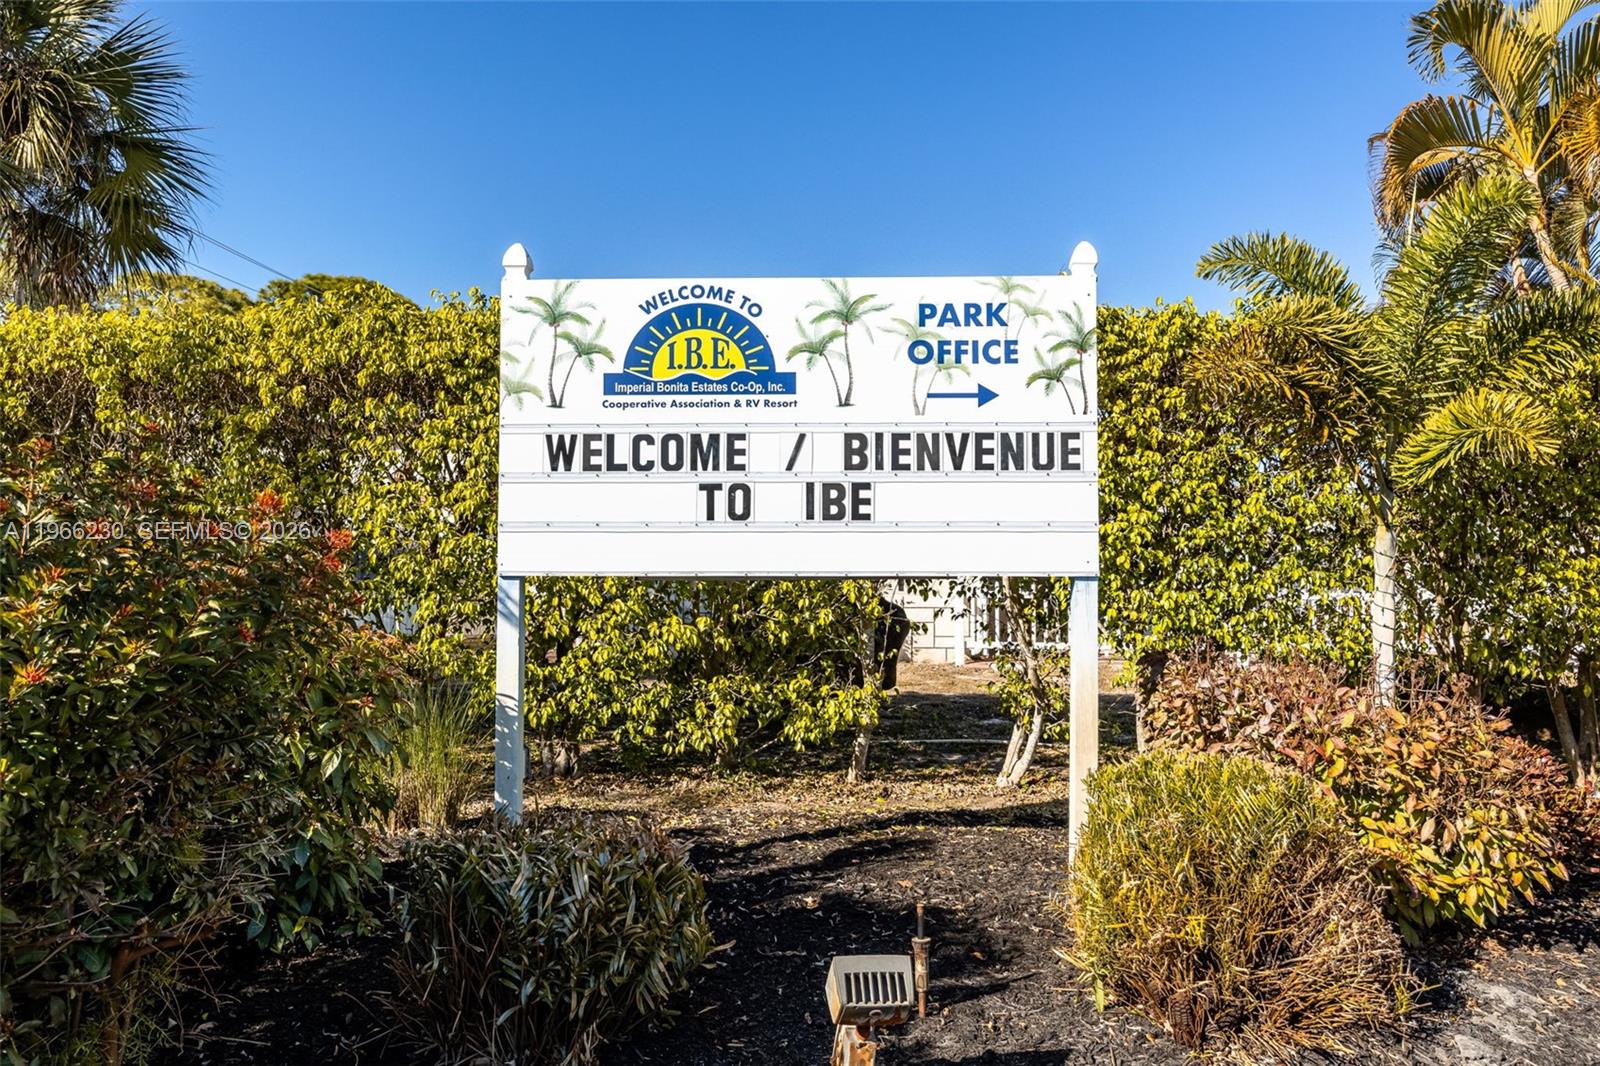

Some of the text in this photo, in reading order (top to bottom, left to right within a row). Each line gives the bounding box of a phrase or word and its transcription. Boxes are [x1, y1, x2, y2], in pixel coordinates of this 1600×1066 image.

[638, 284, 763, 318] WELCOME TO
[918, 302, 1009, 328] PARK
[667, 336, 736, 370] I.B.E.
[907, 339, 1019, 365] OFFICE
[614, 381, 786, 394] Imperial Bonita Estates Co-Op, Inc.
[602, 399, 798, 411] Cooperative Association & RV Resort
[545, 432, 1081, 472] WELCOME / BIENVENUE
[698, 482, 872, 521] TO IBE
